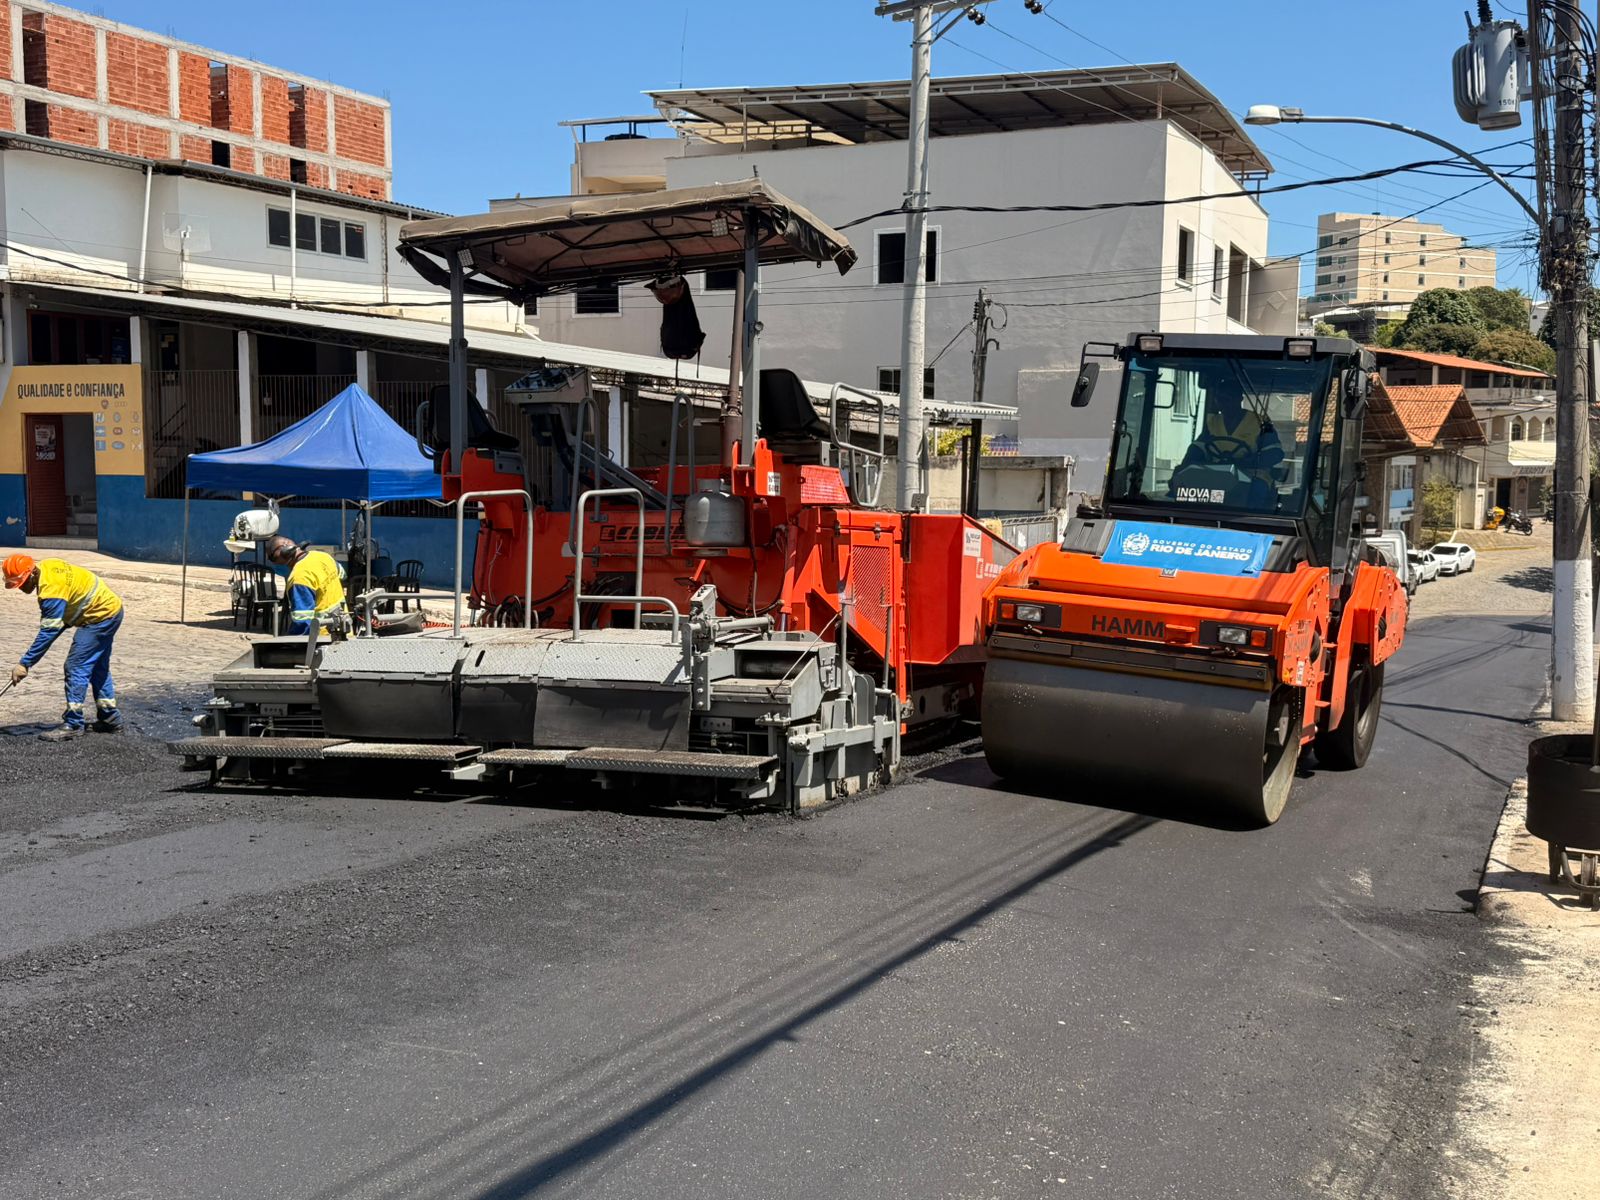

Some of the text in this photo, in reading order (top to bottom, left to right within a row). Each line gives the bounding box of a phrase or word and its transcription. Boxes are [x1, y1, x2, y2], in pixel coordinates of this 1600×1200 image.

[17, 383, 65, 399] QUALIDADE
[74, 383, 125, 399] CONFIANÇA
[1176, 487, 1210, 498] INOVA
[1150, 544, 1251, 561] RIO DE JANEIRO
[1152, 539, 1197, 548] GOVERNO
[1215, 545, 1253, 554] ESTADO
[1092, 614, 1165, 638] HAMM
